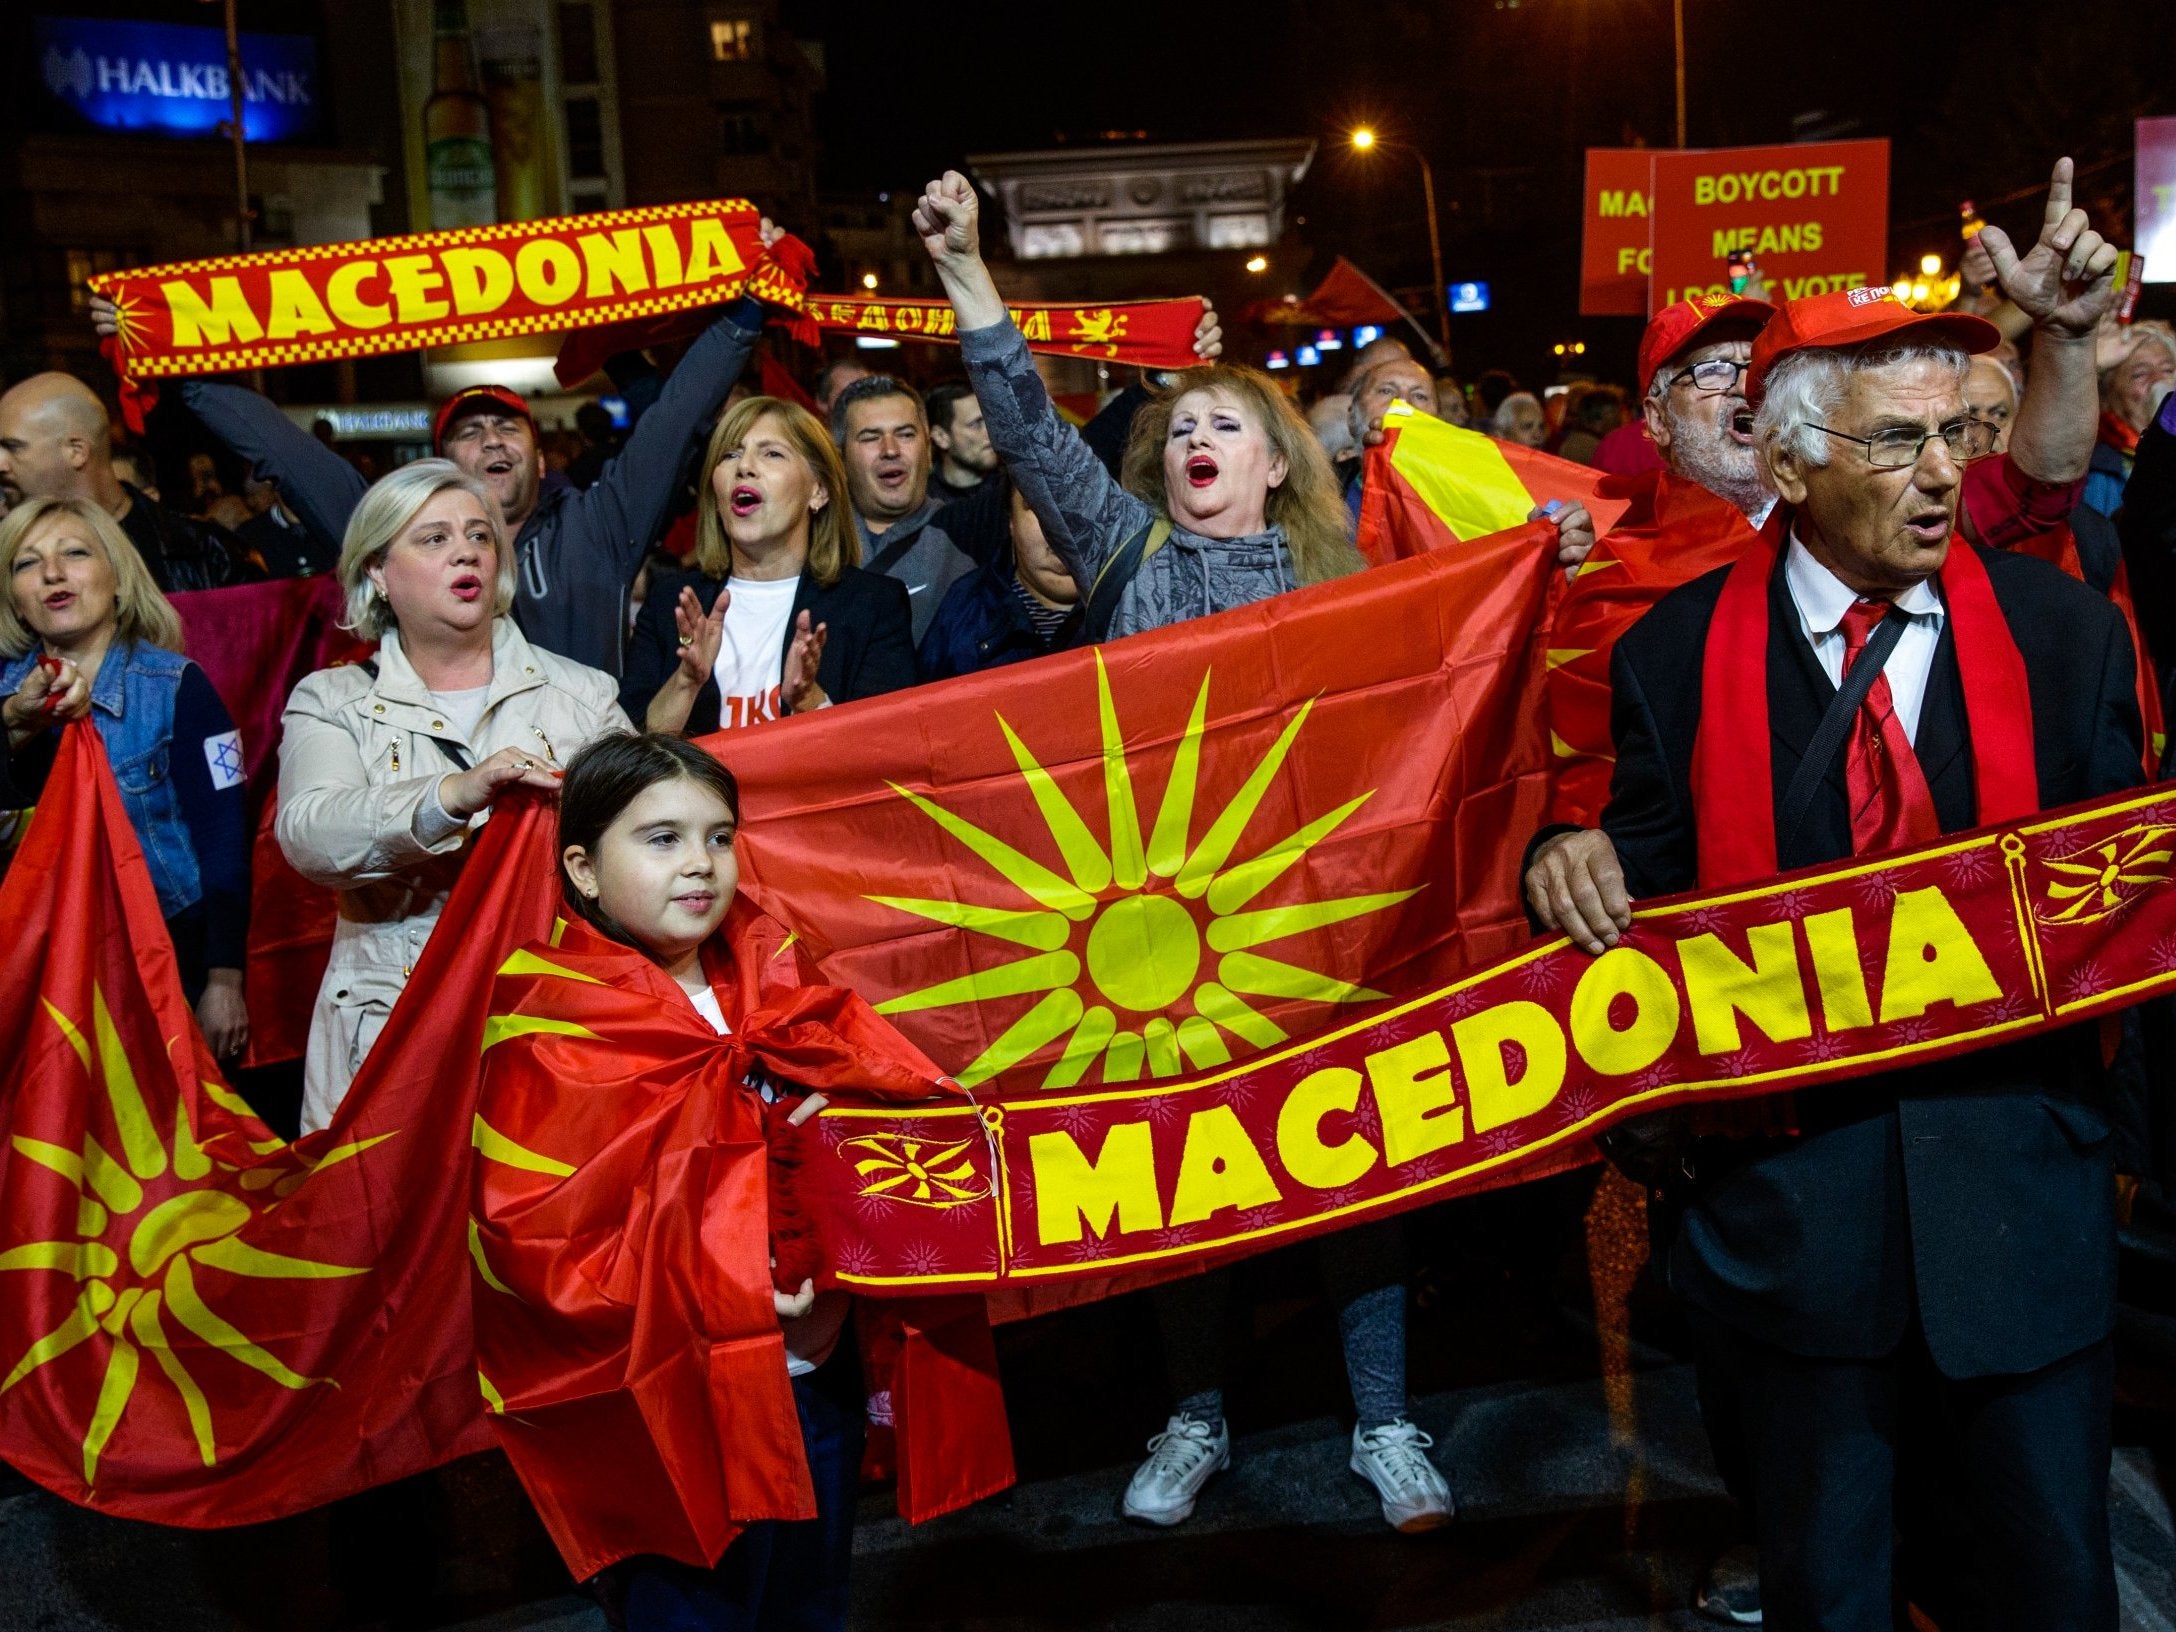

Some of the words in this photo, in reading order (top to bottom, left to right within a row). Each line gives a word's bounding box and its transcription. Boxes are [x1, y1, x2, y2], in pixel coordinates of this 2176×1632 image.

[1695, 165, 1844, 206] BOYCOTT
[1713, 222, 1823, 259] MEANS
[160, 219, 746, 348] MACEDONIA
[1029, 886, 2003, 1246] MACEDONIA
